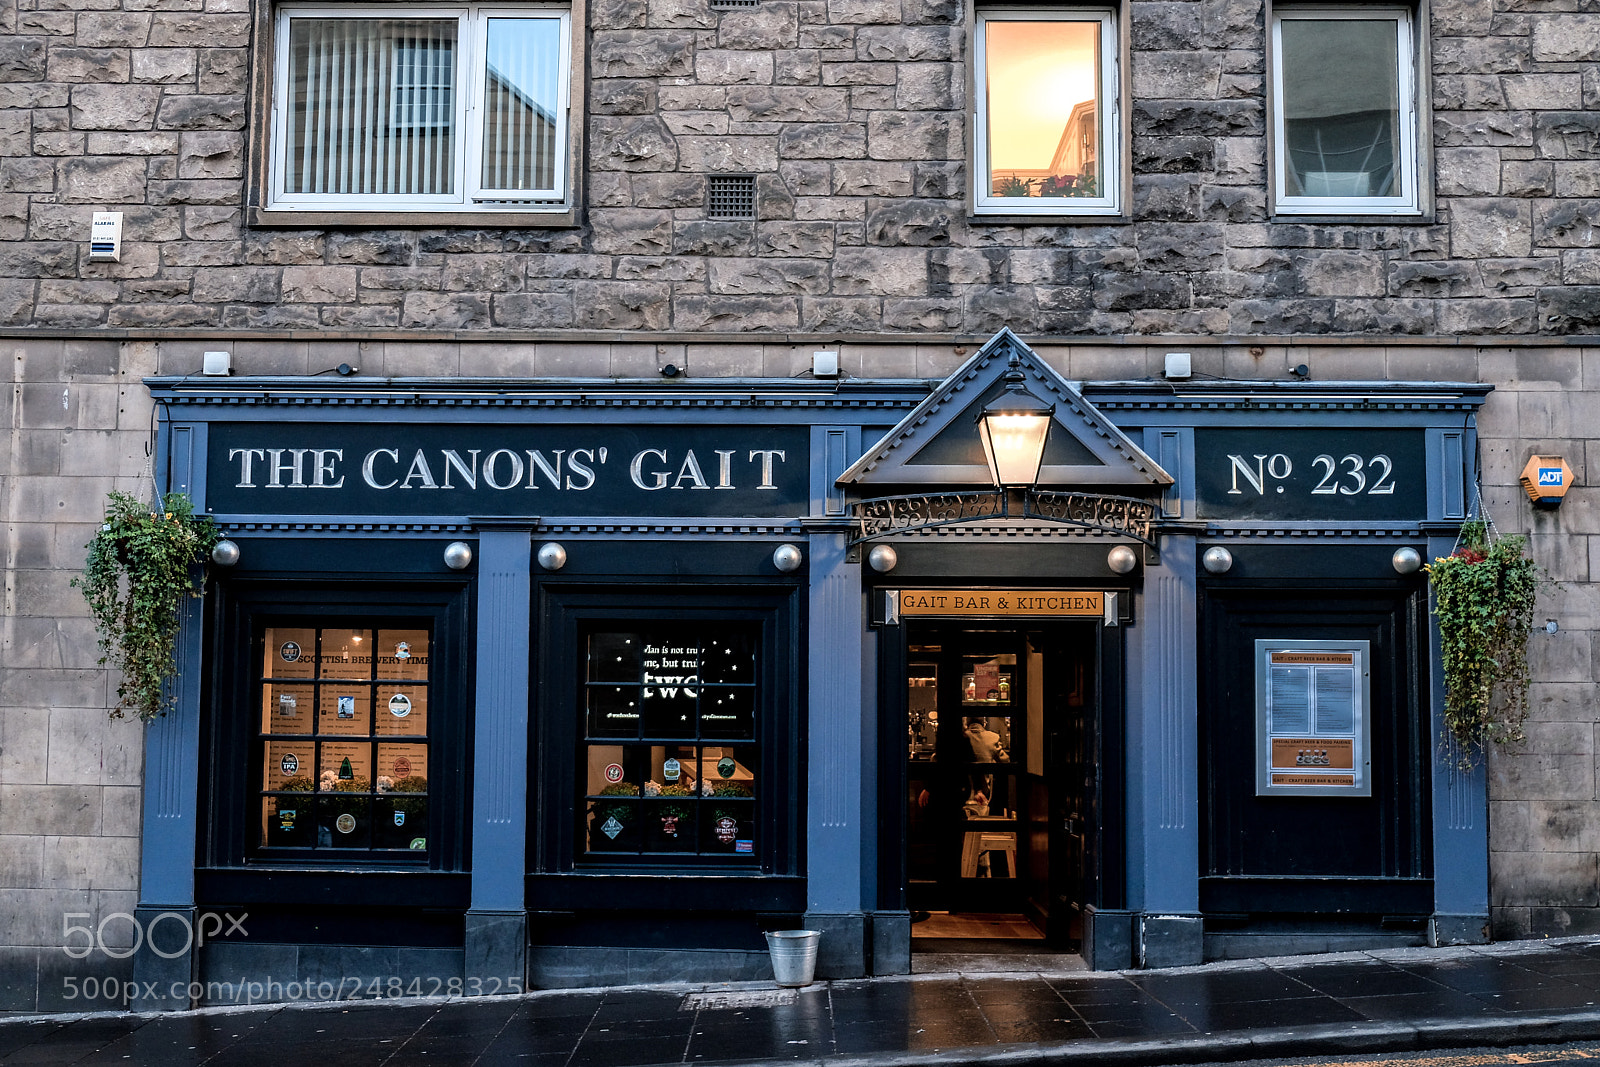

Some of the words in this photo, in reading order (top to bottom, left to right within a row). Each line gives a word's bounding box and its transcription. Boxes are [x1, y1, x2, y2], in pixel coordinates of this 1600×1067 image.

[229, 448, 345, 488] THE
[362, 446, 608, 490] CANONS'
[629, 448, 786, 490] GAIT
[1310, 453, 1396, 495] 232
[1538, 471, 1563, 483] ADT
[903, 595, 948, 608] GAIT
[953, 596, 991, 609] BAR
[997, 597, 1010, 609] &
[1016, 597, 1098, 610] KITCHEN
[661, 645, 669, 654] is
[662, 657, 679, 668] but
[644, 671, 705, 698] two
